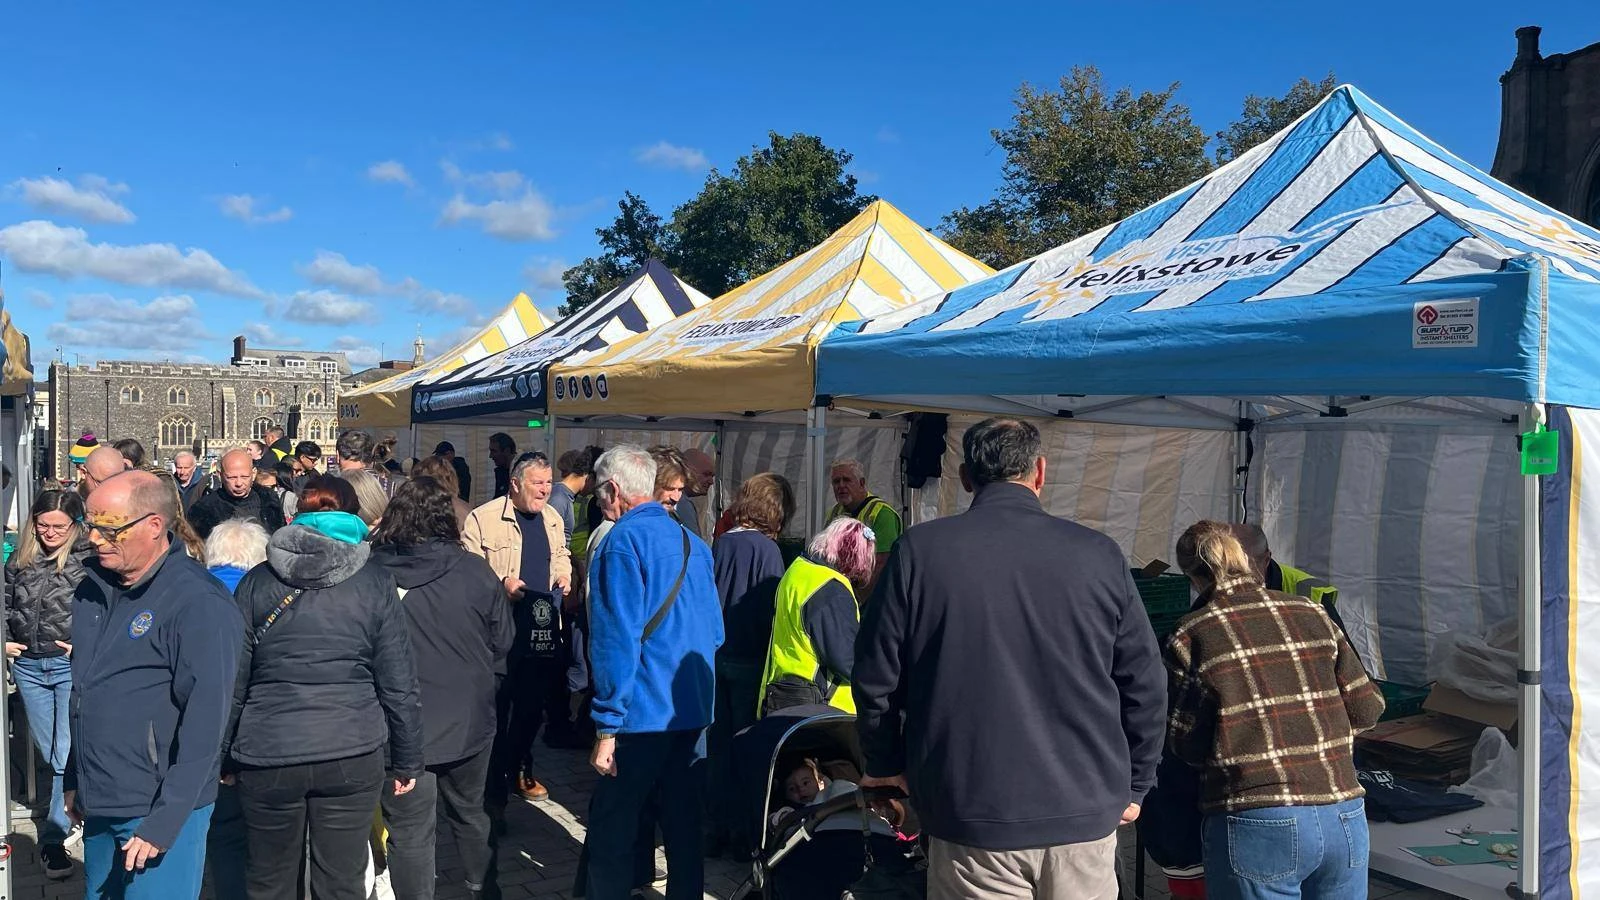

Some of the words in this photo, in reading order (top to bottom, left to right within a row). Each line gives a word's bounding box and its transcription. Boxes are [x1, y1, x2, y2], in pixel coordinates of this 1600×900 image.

[1165, 239, 1234, 260] VISIT
[1065, 243, 1301, 289] felixstowe
[1213, 269, 1243, 281] THE
[1242, 264, 1277, 277] SEA
